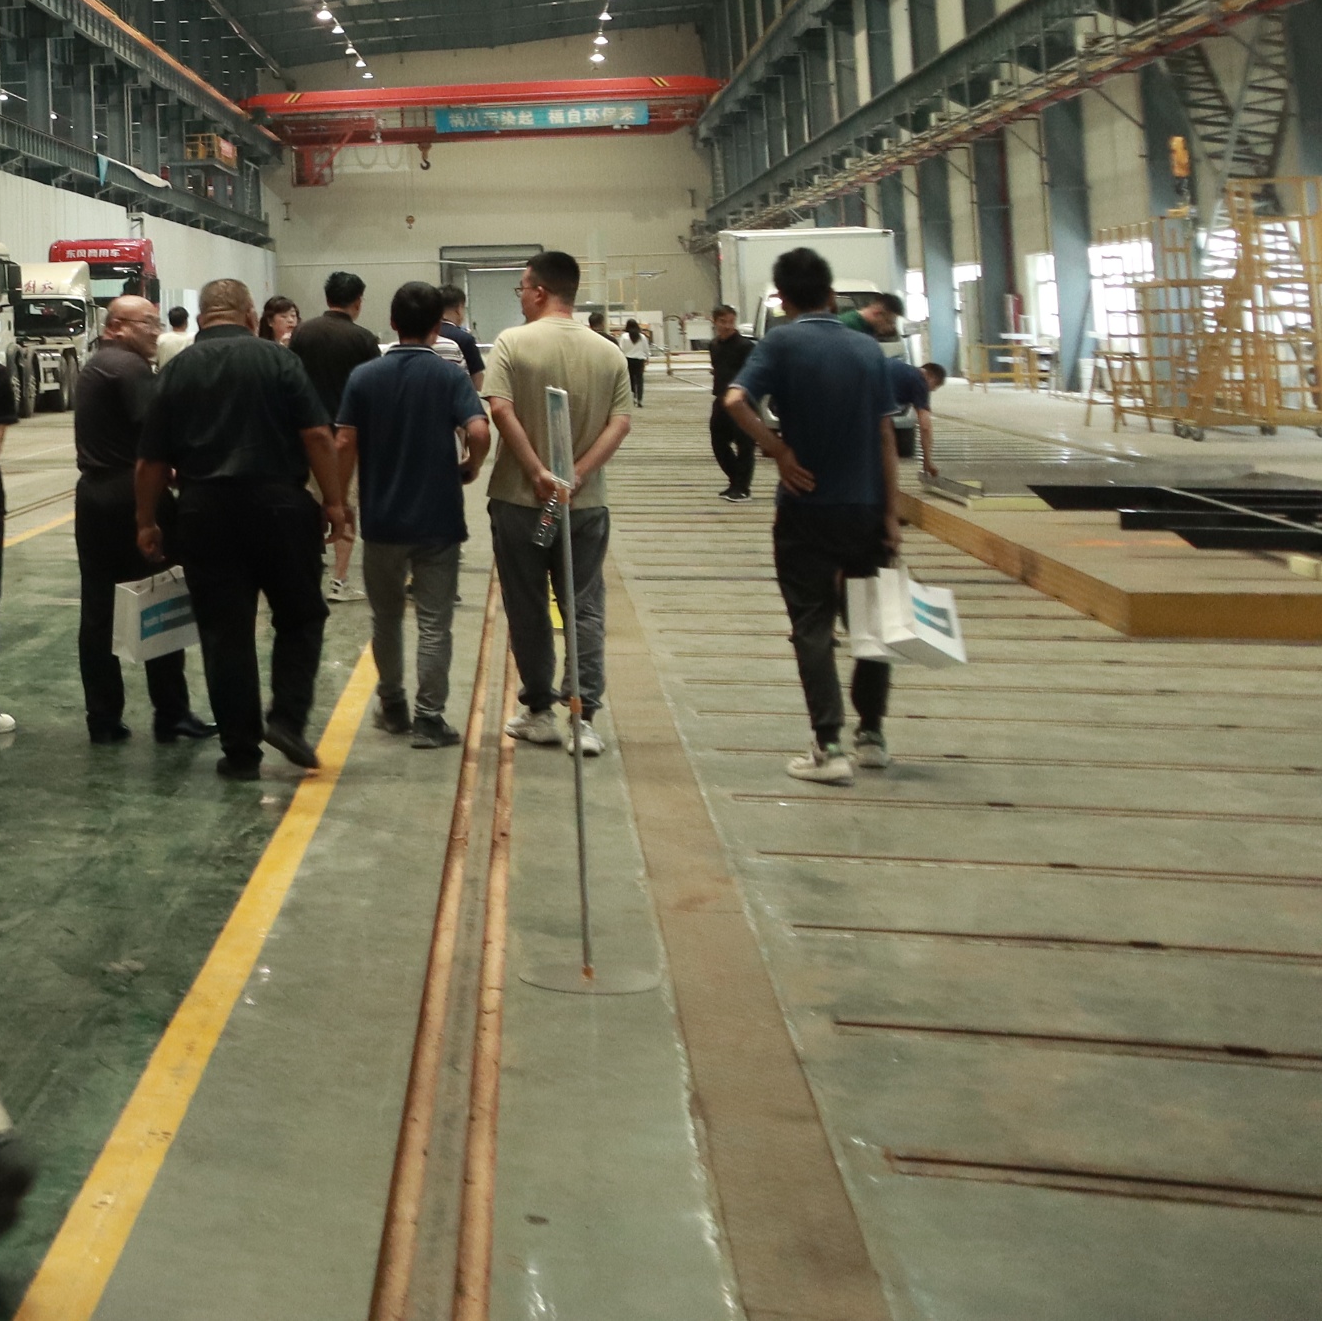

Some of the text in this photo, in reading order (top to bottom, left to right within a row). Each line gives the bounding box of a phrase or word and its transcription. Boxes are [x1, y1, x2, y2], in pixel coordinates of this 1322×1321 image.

[548, 107, 636, 125] 福自环保来
[65, 248, 121, 259] 东风商用车
